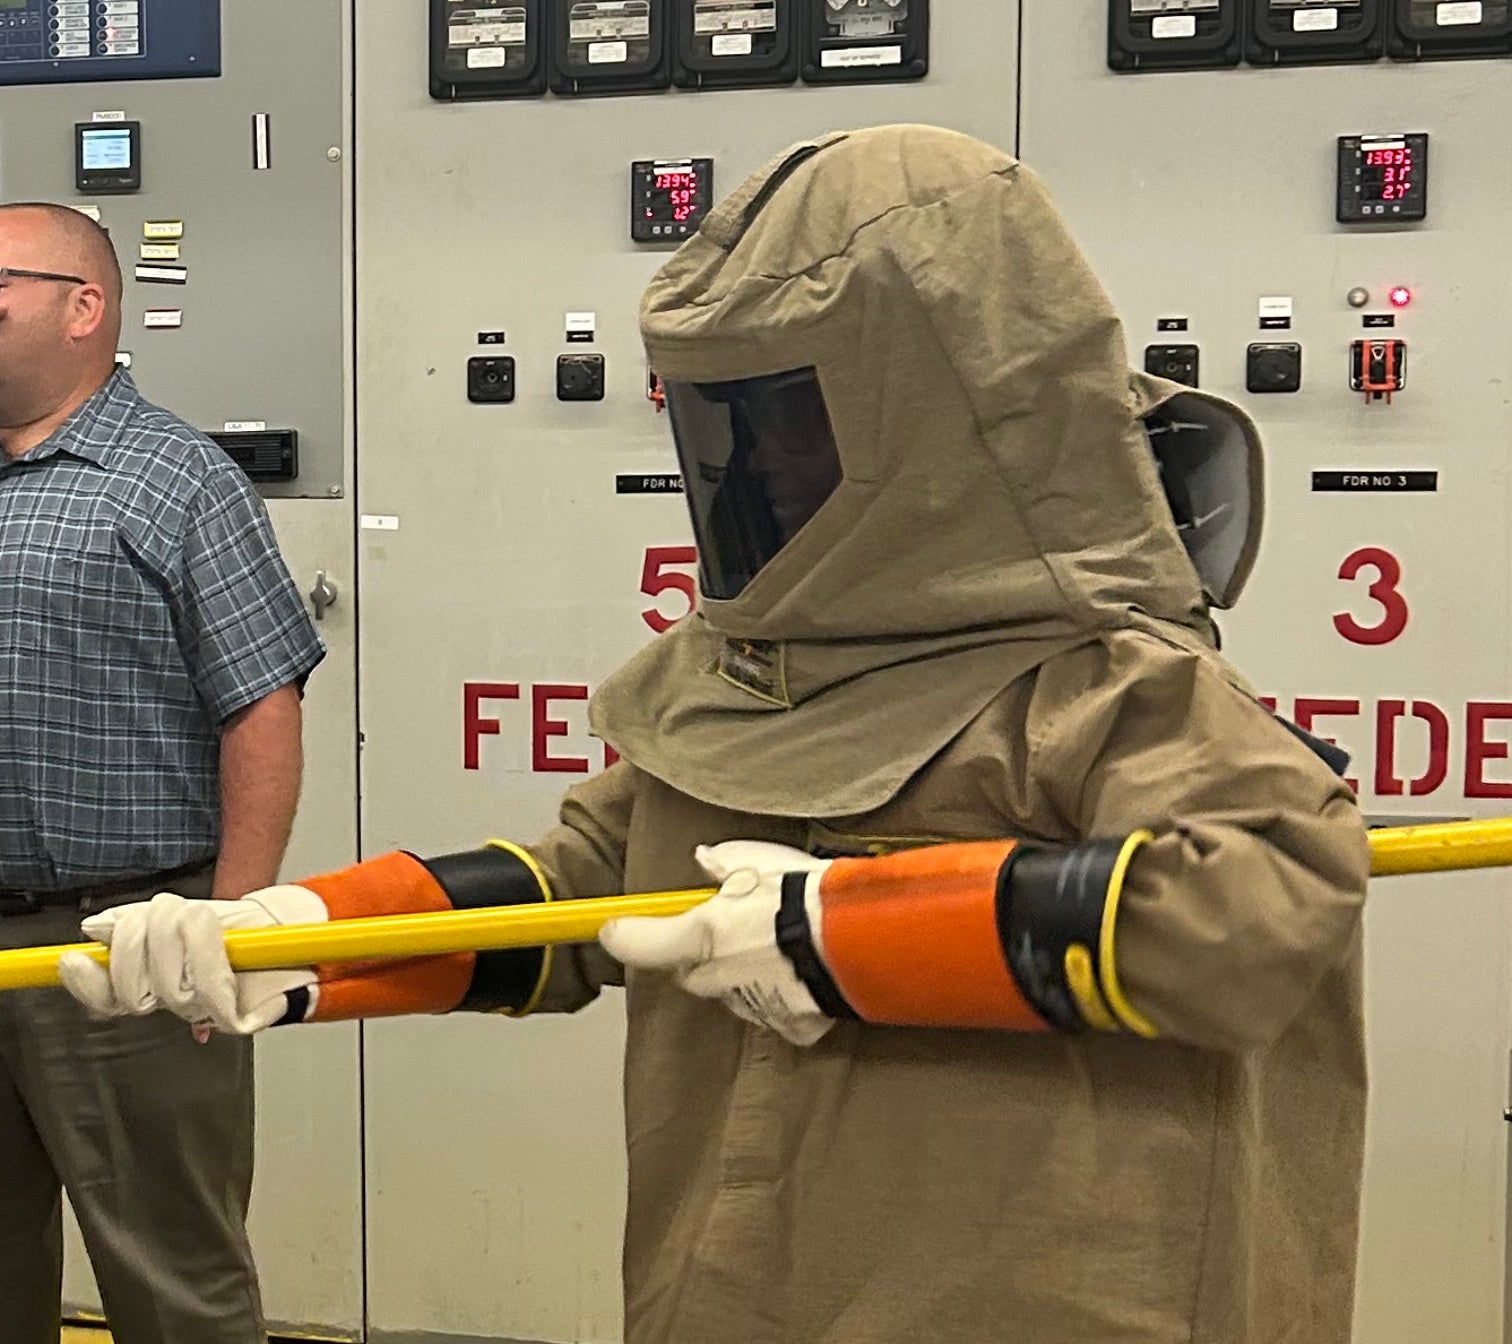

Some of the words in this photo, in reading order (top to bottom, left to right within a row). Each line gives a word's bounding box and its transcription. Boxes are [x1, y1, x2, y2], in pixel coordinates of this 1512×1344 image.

[642, 478, 666, 489] FDR
[1342, 475, 1369, 486] FDR
[1372, 475, 1391, 486] NO
[1397, 475, 1407, 487] 3
[640, 546, 697, 633] 5
[1332, 547, 1409, 646] 3
[463, 682, 620, 774] FE
